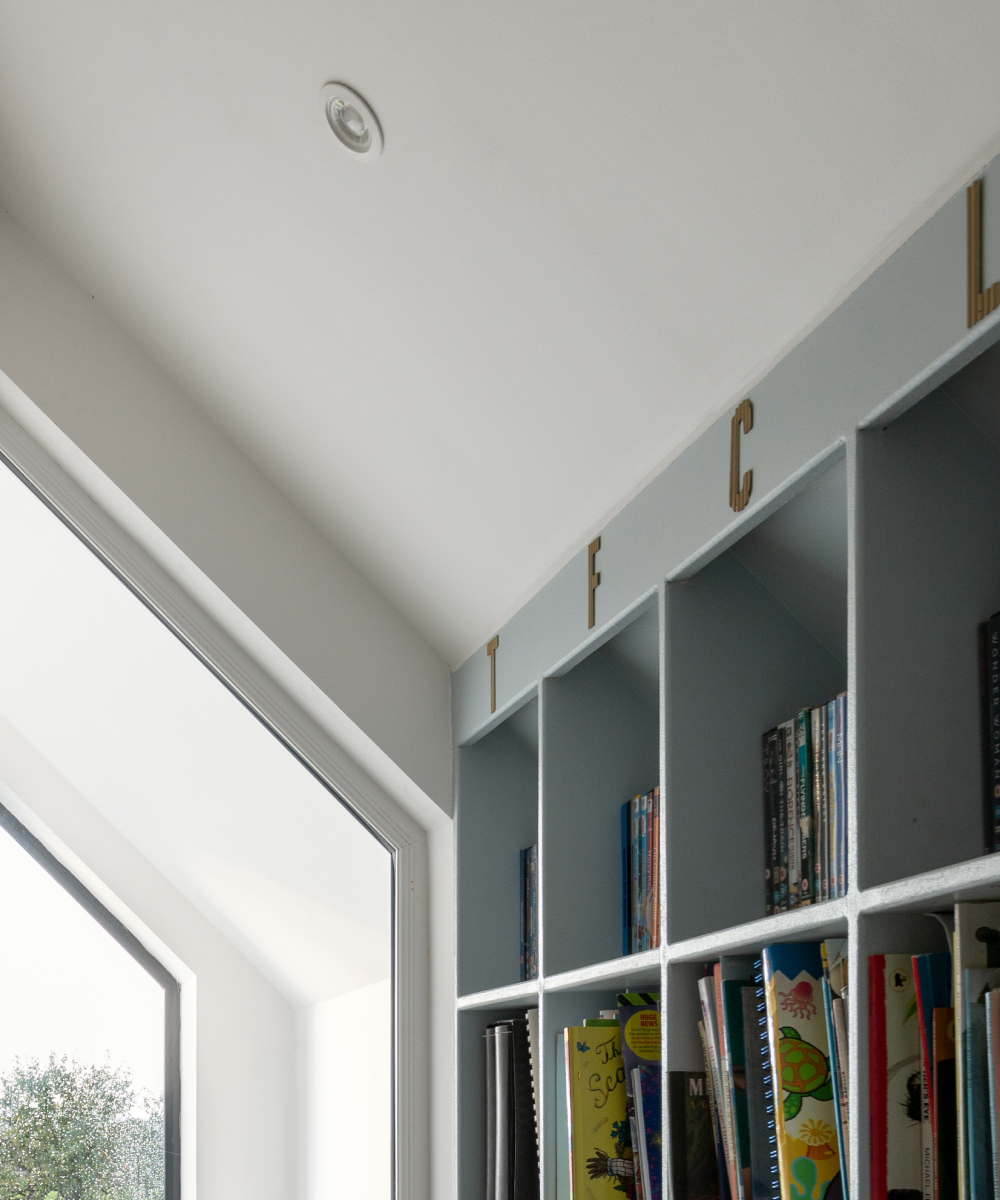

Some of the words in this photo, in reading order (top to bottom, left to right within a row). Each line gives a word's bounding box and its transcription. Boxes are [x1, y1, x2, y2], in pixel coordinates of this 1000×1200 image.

[966, 180, 1000, 328] L
[728, 398, 753, 512] C
[587, 535, 602, 629] F
[486, 634, 500, 713] T
[990, 630, 999, 707] WONDER
[762, 744, 770, 793] TROY
[992, 713, 1000, 779] WOMAN
[786, 777, 796, 845] FLORENCE
[595, 1035, 622, 1064] Th
[718, 1102, 730, 1164] experiments
[923, 1147, 931, 1188] MICHAEL
